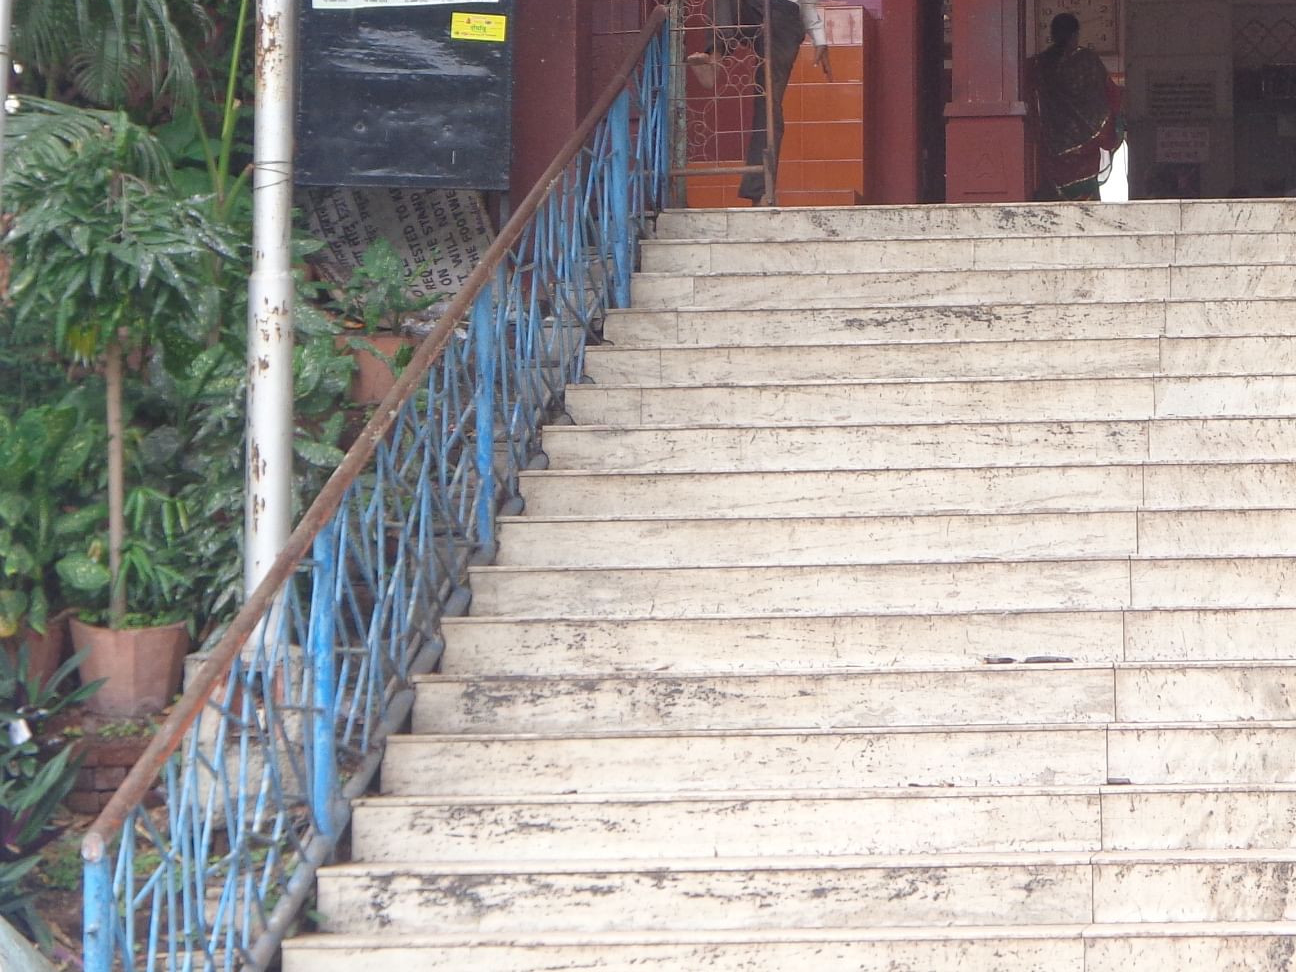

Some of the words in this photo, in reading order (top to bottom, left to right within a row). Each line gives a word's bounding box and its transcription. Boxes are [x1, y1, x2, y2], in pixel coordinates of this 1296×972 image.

[410, 192, 434, 236] STAND
[403, 225, 437, 290] REQESTED
[444, 231, 463, 268] WILL
[466, 244, 480, 268] HE
[437, 268, 452, 285] ON
